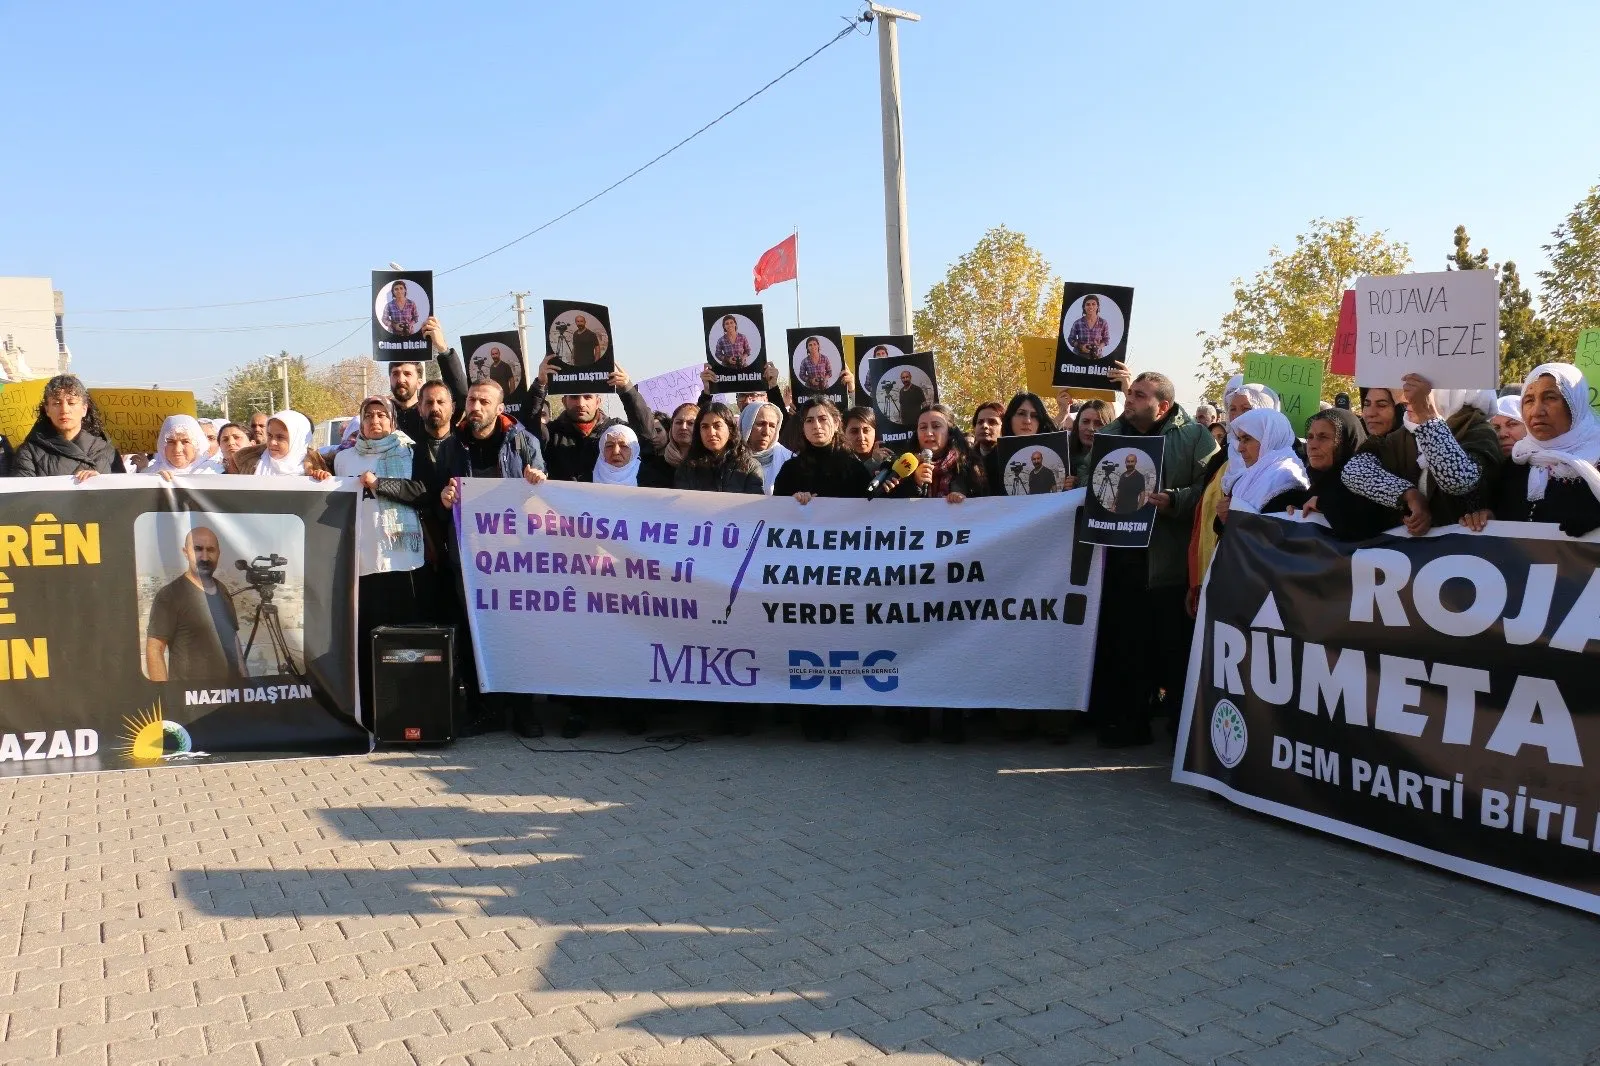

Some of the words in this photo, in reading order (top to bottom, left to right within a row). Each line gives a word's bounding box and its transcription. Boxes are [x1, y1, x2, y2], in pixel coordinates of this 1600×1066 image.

[1368, 286, 1448, 315] ROJAVA
[378, 340, 402, 350] Cihan
[402, 339, 428, 350] BİLGİN
[1368, 331, 1388, 357] BI
[1395, 322, 1487, 358] PAREZE
[552, 373, 578, 382] Nazım
[737, 371, 762, 381] BİLGİN
[1060, 363, 1087, 374] Cihan
[881, 431, 907, 442] Nazım
[474, 508, 518, 535] WÊ
[527, 509, 629, 541] PÊNÛSA
[639, 521, 680, 545] ME
[687, 520, 714, 548] JÎ
[722, 522, 740, 549] Û
[766, 525, 926, 551] KALEMİMİZ
[935, 529, 972, 550] DE
[1087, 518, 1116, 531] Nazım
[1116, 521, 1148, 533] DAŞTAN
[475, 550, 617, 578] QAMERAYA
[625, 557, 662, 581] ME
[670, 557, 696, 583] JÎ
[762, 561, 937, 587] KAMERAMIZ
[946, 560, 986, 584] DA
[475, 588, 499, 611] LI
[508, 585, 577, 613] ERDÊ
[586, 590, 699, 620] NEMÎNIN
[761, 601, 856, 626] YERDE
[648, 642, 761, 688] MKG
[788, 649, 899, 693] DFG
[1212, 590, 1584, 767] RÛMETA
[185, 688, 240, 706] NAZIM
[243, 684, 313, 705] DAŞTAN
[0, 728, 99, 762] AZAD
[1271, 735, 1340, 787] DEM
[1352, 758, 1464, 820] PARTİ
